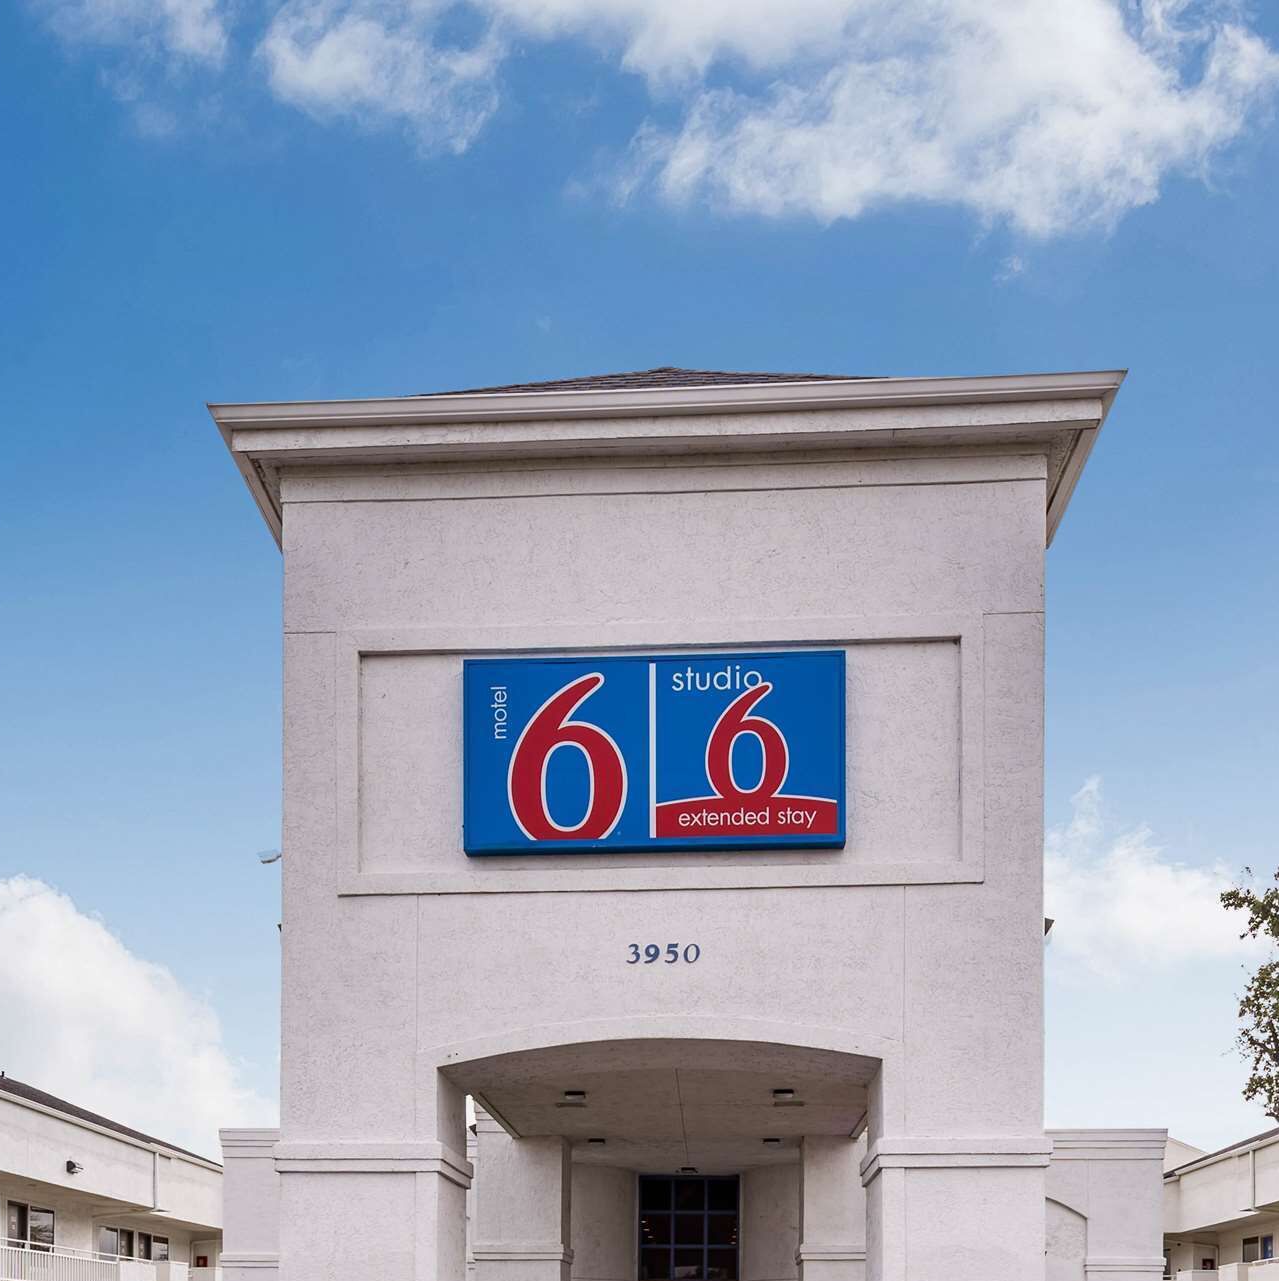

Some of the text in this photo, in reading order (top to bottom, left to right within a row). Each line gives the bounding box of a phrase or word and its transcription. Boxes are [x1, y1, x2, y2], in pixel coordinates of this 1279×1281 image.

[671, 665, 763, 692] studio
[490, 685, 508, 740] motel
[507, 671, 628, 841] 6
[704, 681, 790, 799] 6
[678, 807, 817, 830] extended stay
[626, 942, 701, 964] 3950
